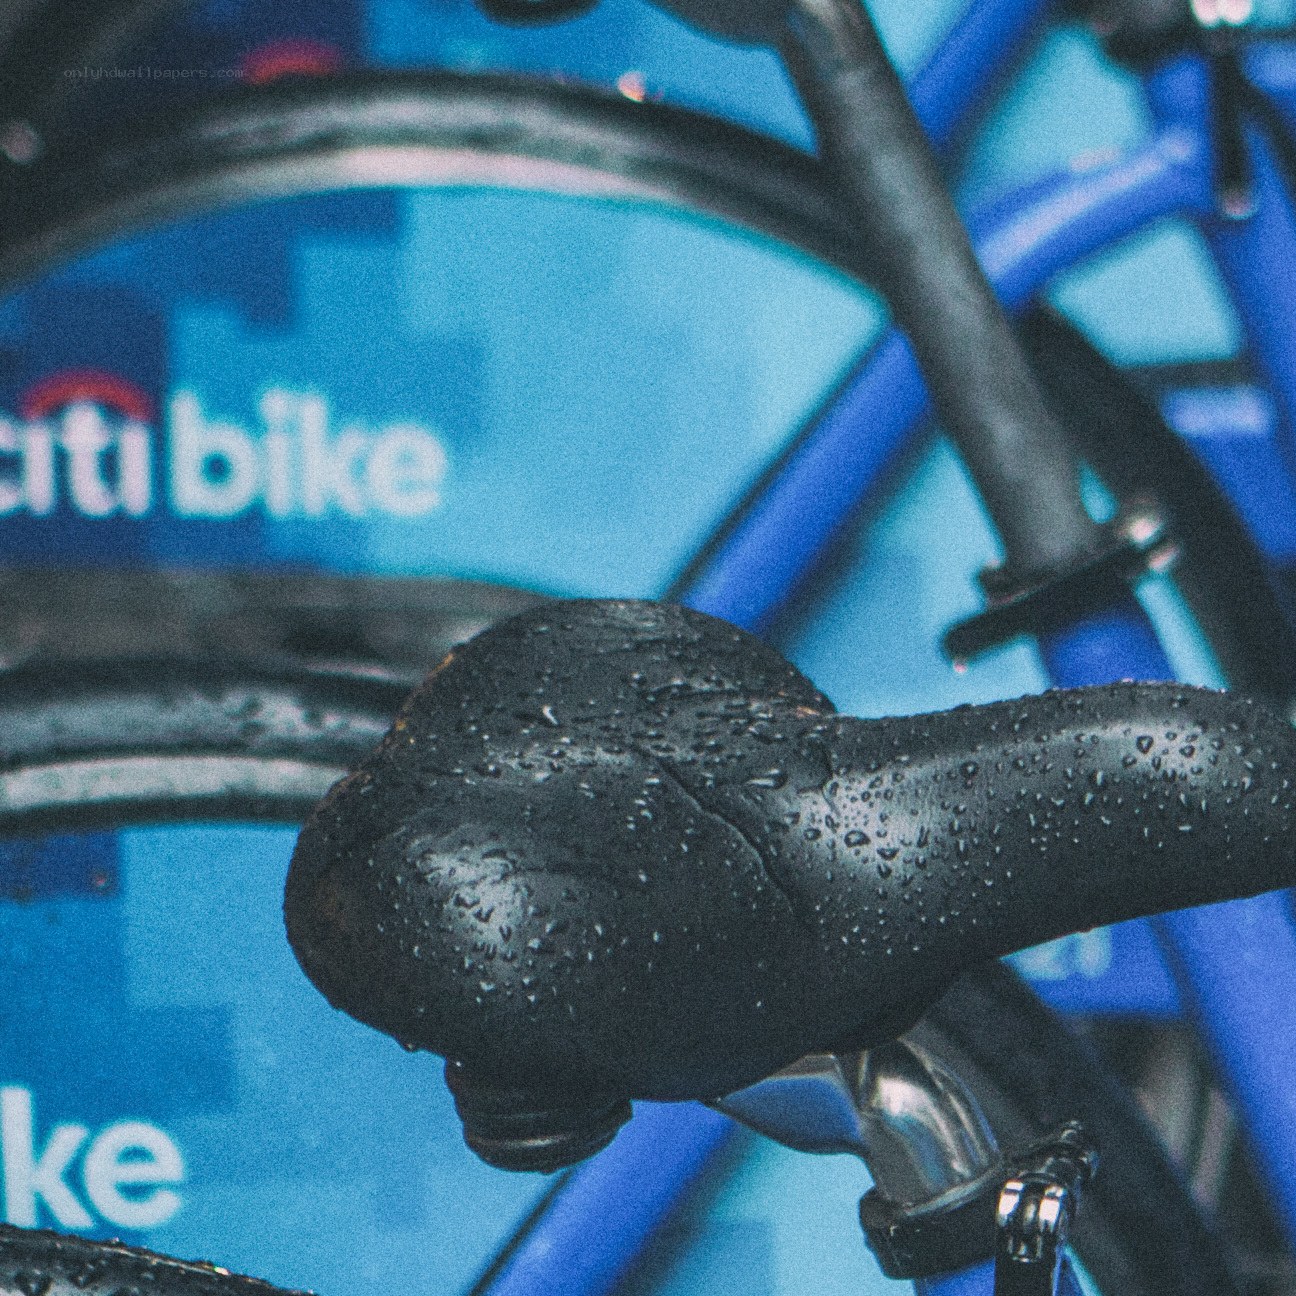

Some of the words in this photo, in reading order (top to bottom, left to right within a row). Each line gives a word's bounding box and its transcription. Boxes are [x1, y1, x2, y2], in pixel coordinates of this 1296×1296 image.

[0, 376, 153, 516] iti
[171, 387, 447, 516] bike
[0, 1085, 184, 1229] ke
